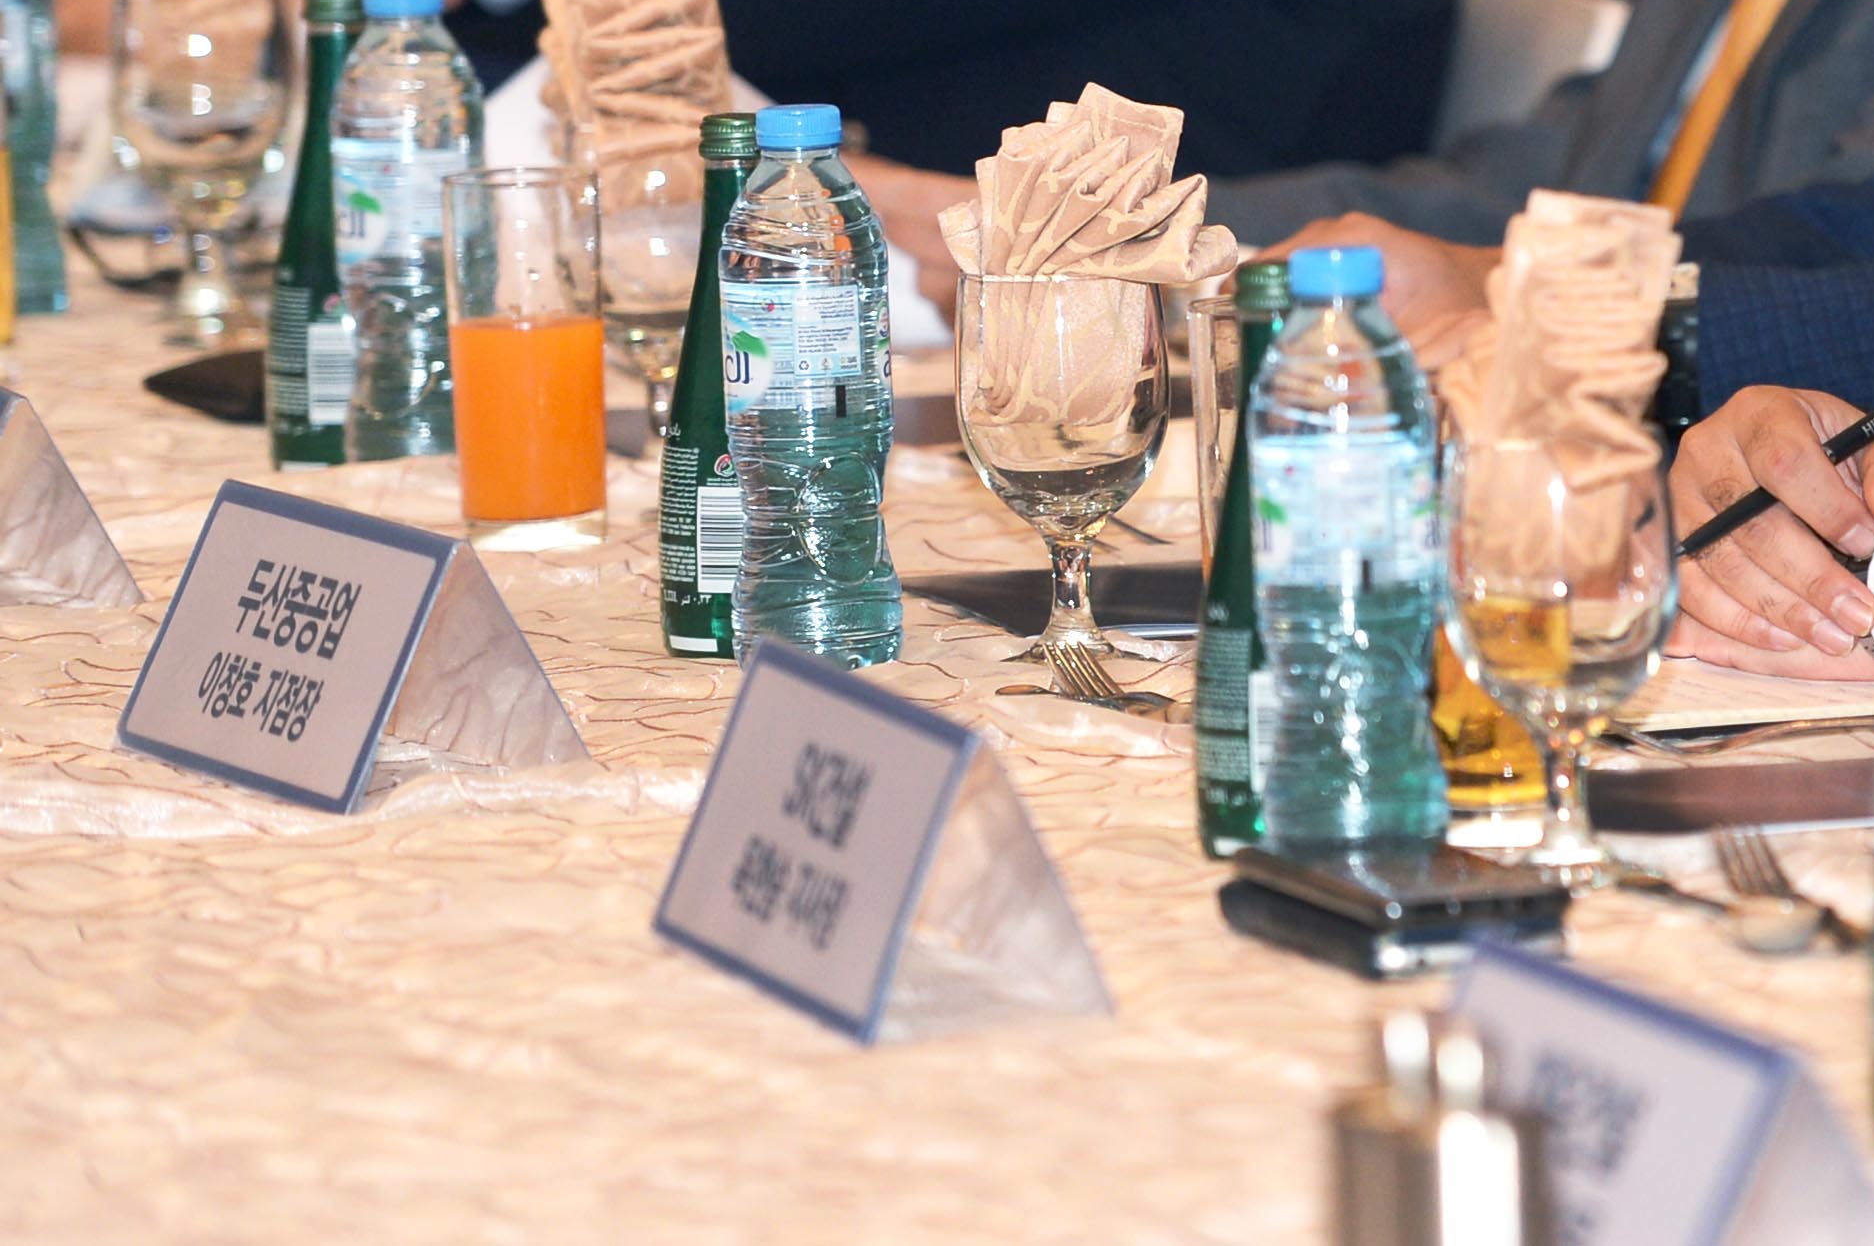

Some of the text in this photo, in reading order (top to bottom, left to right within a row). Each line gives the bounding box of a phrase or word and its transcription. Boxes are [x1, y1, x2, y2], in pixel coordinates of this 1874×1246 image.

[236, 558, 362, 661] 두산중공업
[198, 651, 325, 743] 이창호 지점장
